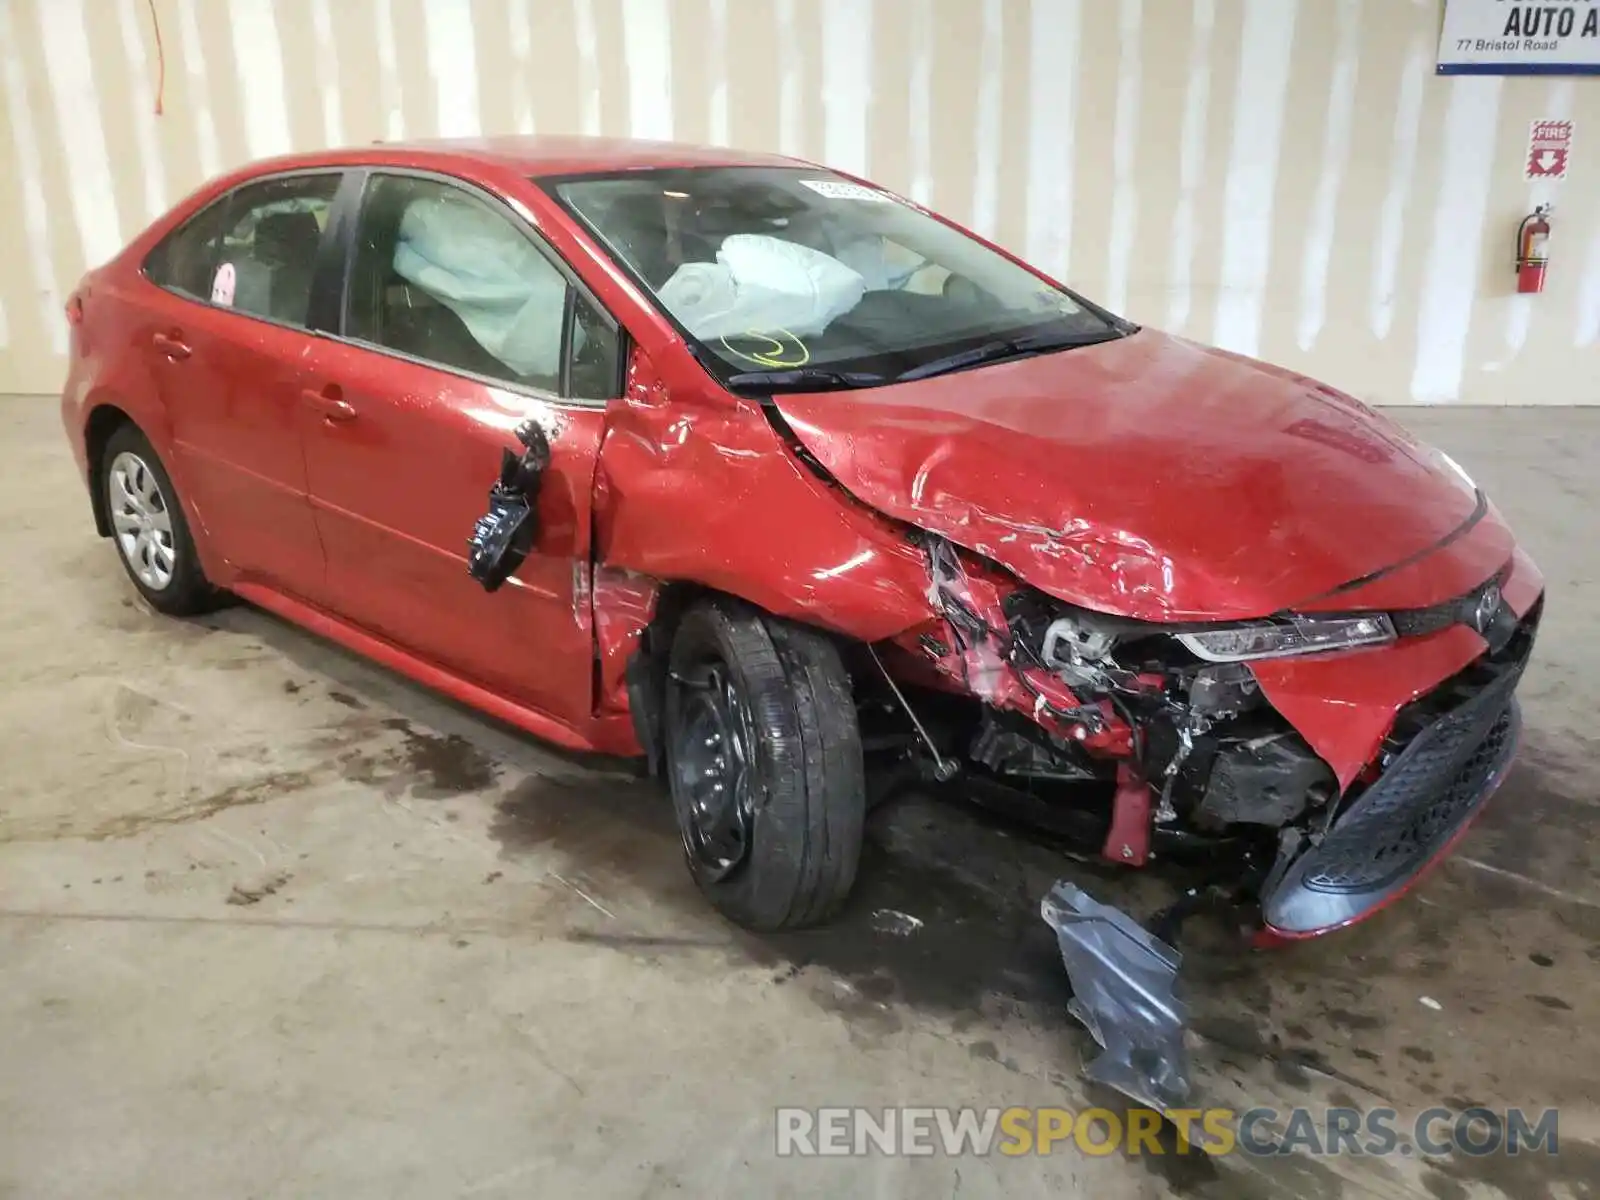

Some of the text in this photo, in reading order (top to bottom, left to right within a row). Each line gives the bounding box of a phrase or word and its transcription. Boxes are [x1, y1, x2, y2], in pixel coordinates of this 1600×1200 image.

[1503, 7, 1600, 38] AUTO A
[1456, 39, 1558, 51] 77 Bristol Road
[1536, 127, 1568, 140] FIRE
